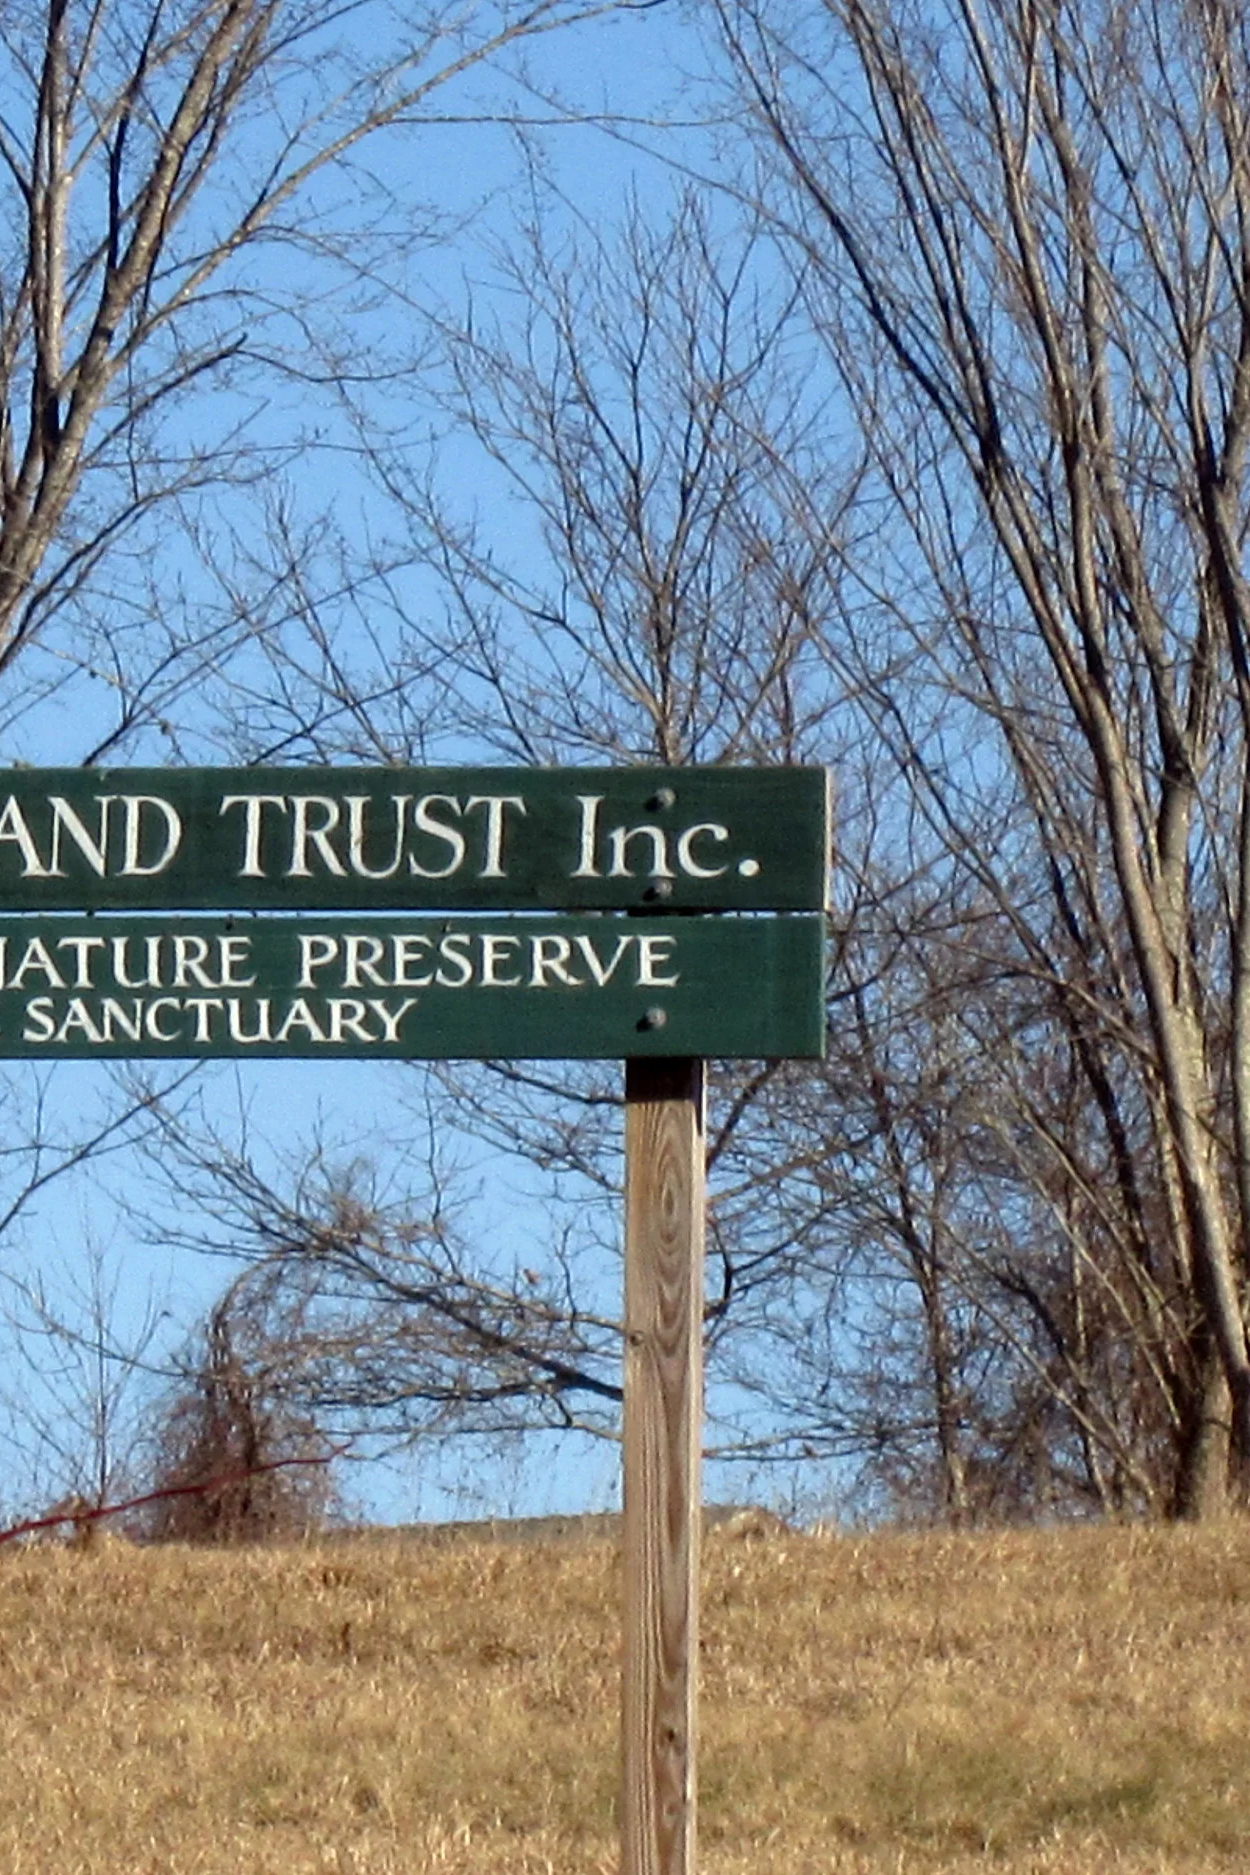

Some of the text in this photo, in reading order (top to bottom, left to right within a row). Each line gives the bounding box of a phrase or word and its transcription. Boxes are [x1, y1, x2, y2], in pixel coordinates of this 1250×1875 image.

[220, 794, 526, 879] TRUST
[570, 794, 762, 879] Inc.
[296, 933, 679, 989] PRESERVE
[22, 996, 418, 1044] SANCTUARY
